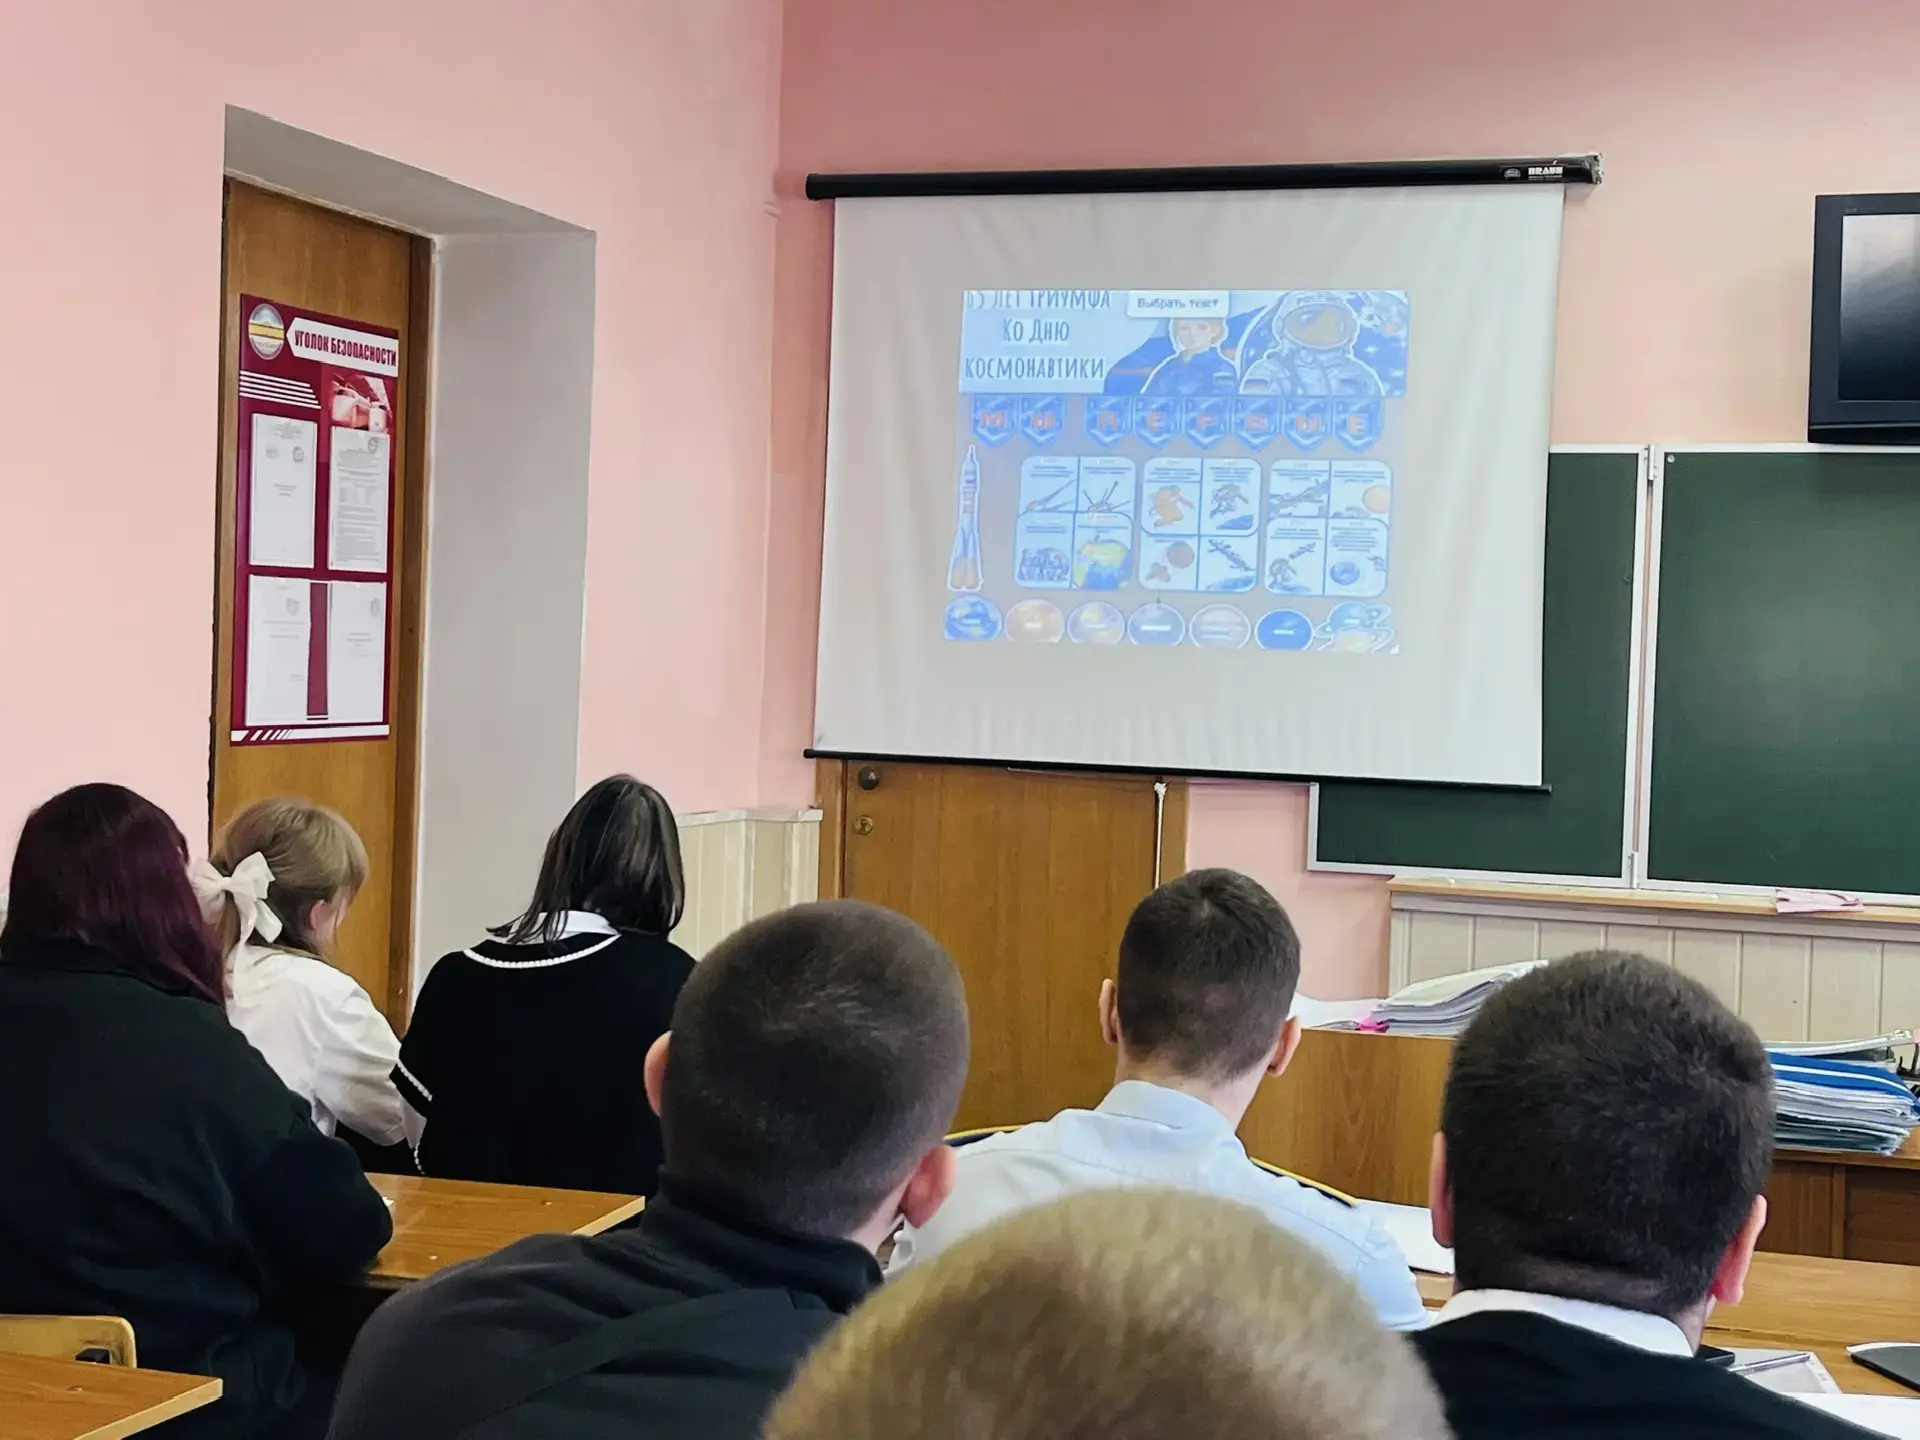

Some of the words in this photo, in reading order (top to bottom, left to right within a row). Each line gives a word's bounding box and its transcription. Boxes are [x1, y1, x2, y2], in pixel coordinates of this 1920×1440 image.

[1138, 298, 1186, 309] Выбрать
[1190, 299, 1219, 308] текст
[295, 330, 329, 352] УГОЛОК
[331, 338, 396, 367] БЕЗОПАСНОСТИ
[965, 357, 1104, 379] КОСМОНАВТИКИ
[980, 411, 1055, 429] МЫ
[1098, 410, 1369, 434] ПЕРВЫЕ
